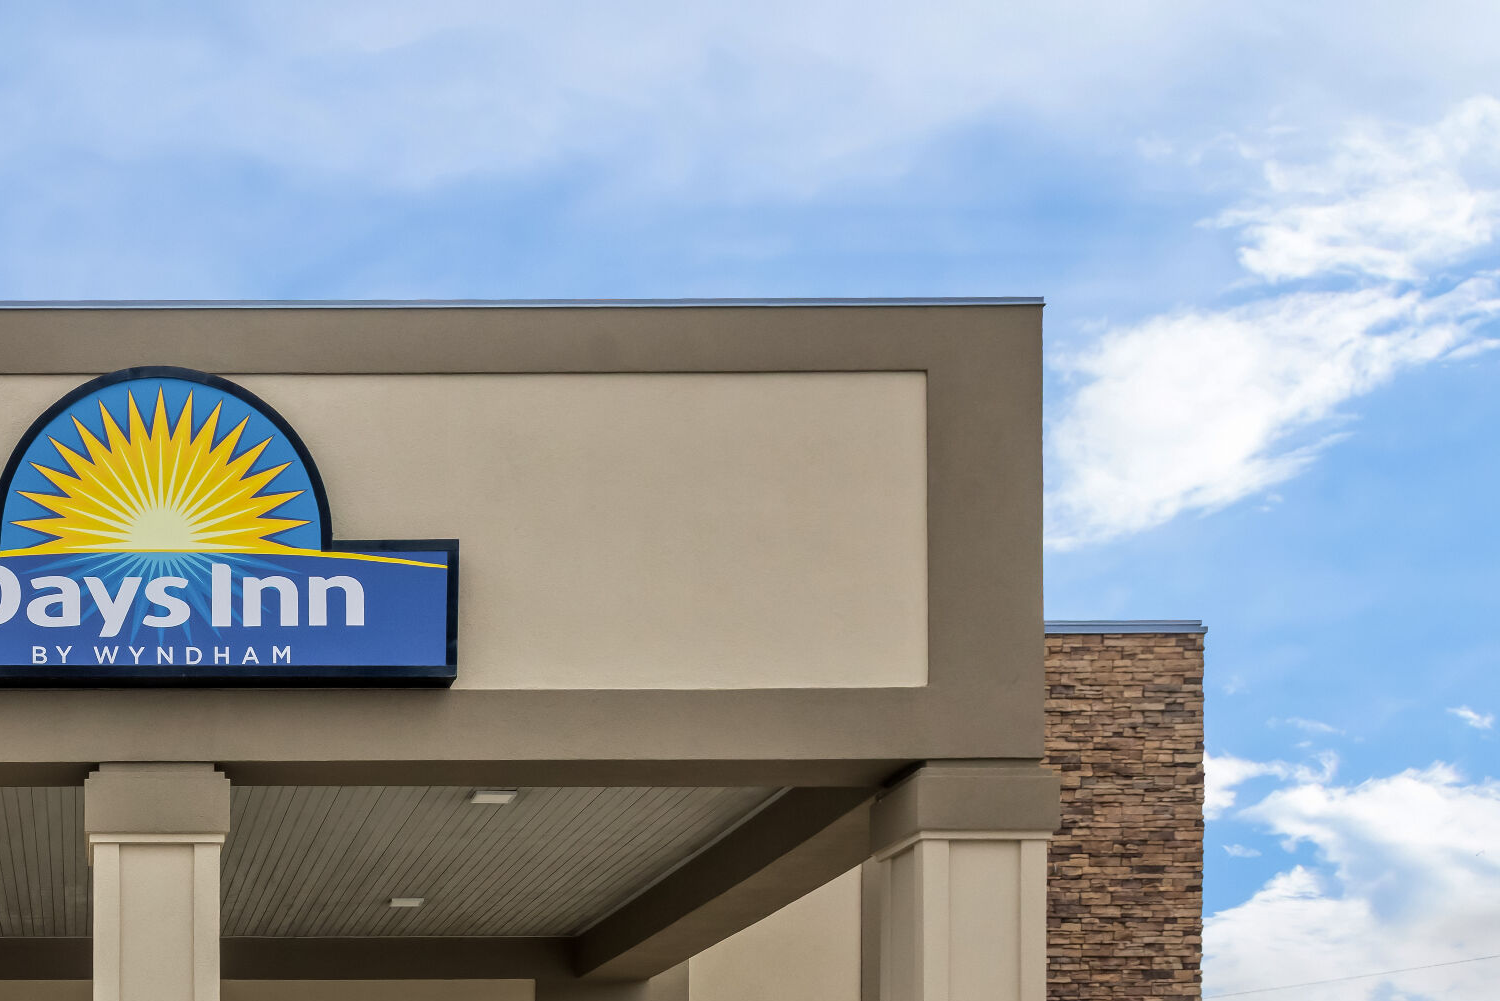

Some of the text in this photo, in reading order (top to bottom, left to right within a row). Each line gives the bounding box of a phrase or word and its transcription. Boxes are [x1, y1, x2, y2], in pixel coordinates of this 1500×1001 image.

[211, 562, 365, 627] Inn
[32, 645, 293, 665] BY WYNDHAM
